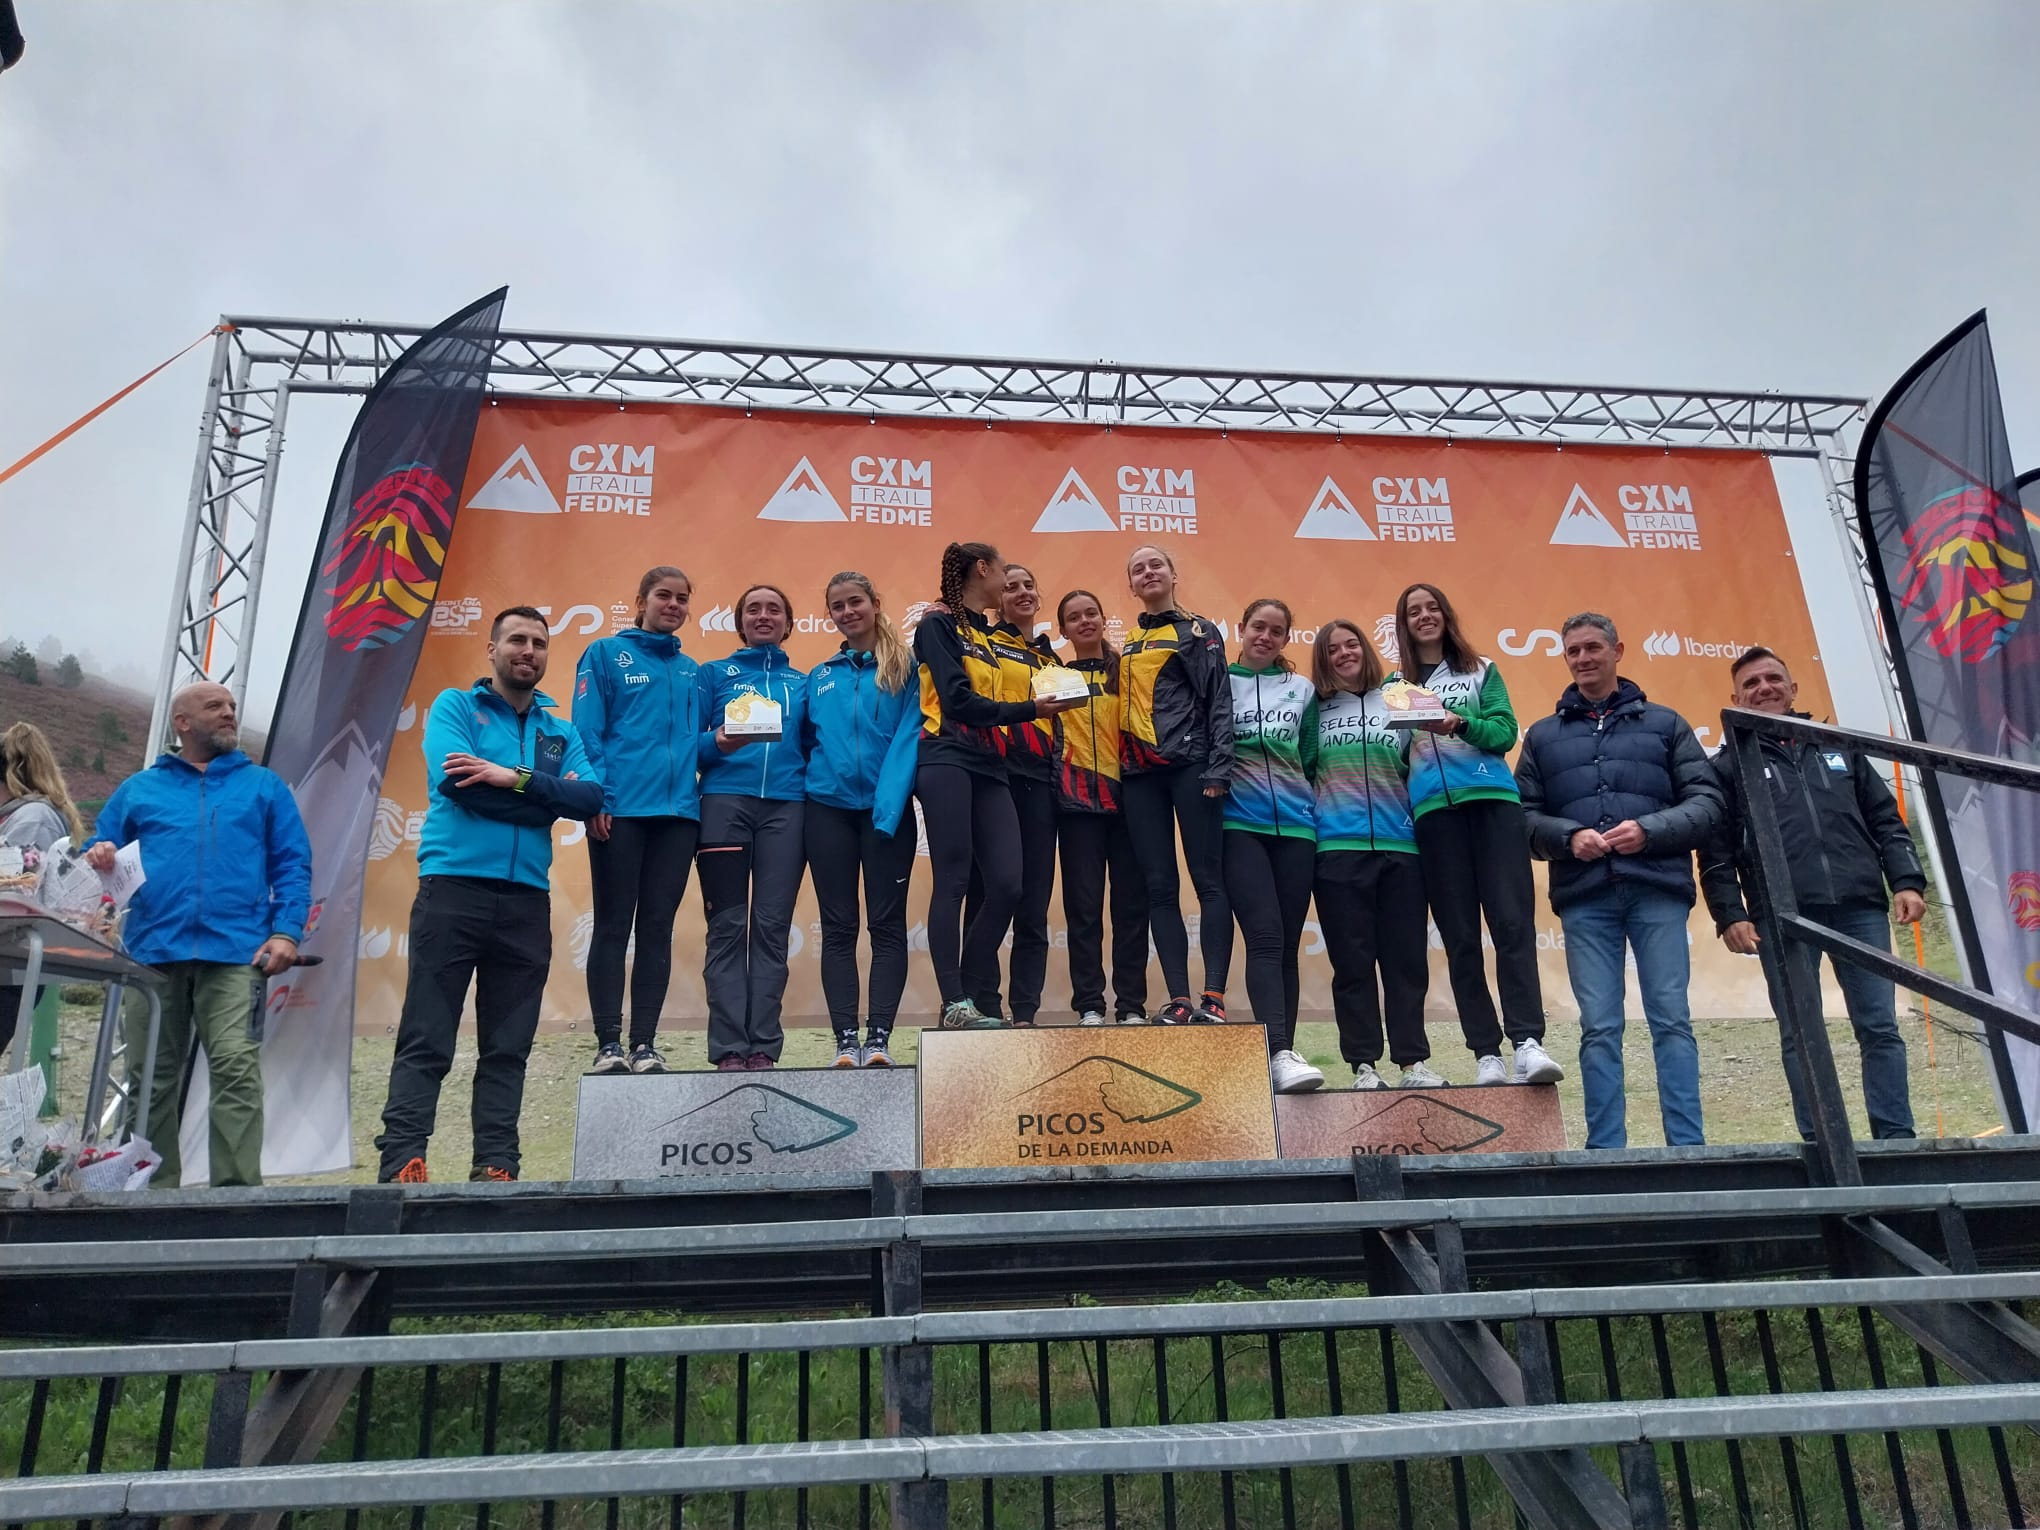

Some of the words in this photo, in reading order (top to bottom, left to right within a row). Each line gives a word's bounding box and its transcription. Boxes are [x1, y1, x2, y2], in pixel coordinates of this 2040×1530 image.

[569, 444, 655, 474] CXM
[850, 455, 932, 488] CXM
[1117, 465, 1194, 496] CXM
[575, 476, 645, 495] TRAIL
[1372, 476, 1448, 505] CXM
[565, 495, 651, 516] FEDME
[858, 487, 924, 506] TRAIL
[1126, 496, 1191, 515] TRAIL
[1618, 484, 1693, 512] CXM
[850, 505, 932, 527] FEDME
[1382, 506, 1447, 523] TRAIL
[1630, 514, 1692, 531] TRAIL
[1120, 516, 1198, 535] FEDME
[1377, 525, 1456, 542] FEDME
[1627, 532, 1701, 551] FEDME
[1684, 637, 1773, 659] Iberdr
[1233, 709, 1301, 726] LECCIÓN
[1319, 715, 1381, 734] SELECC
[1017, 1112, 1105, 1136] PICOS
[660, 1142, 753, 1166] PICOS
[1018, 1142, 1043, 1158] DE
[1048, 1142, 1071, 1158] LA
[1076, 1140, 1174, 1157] DEMANDA
